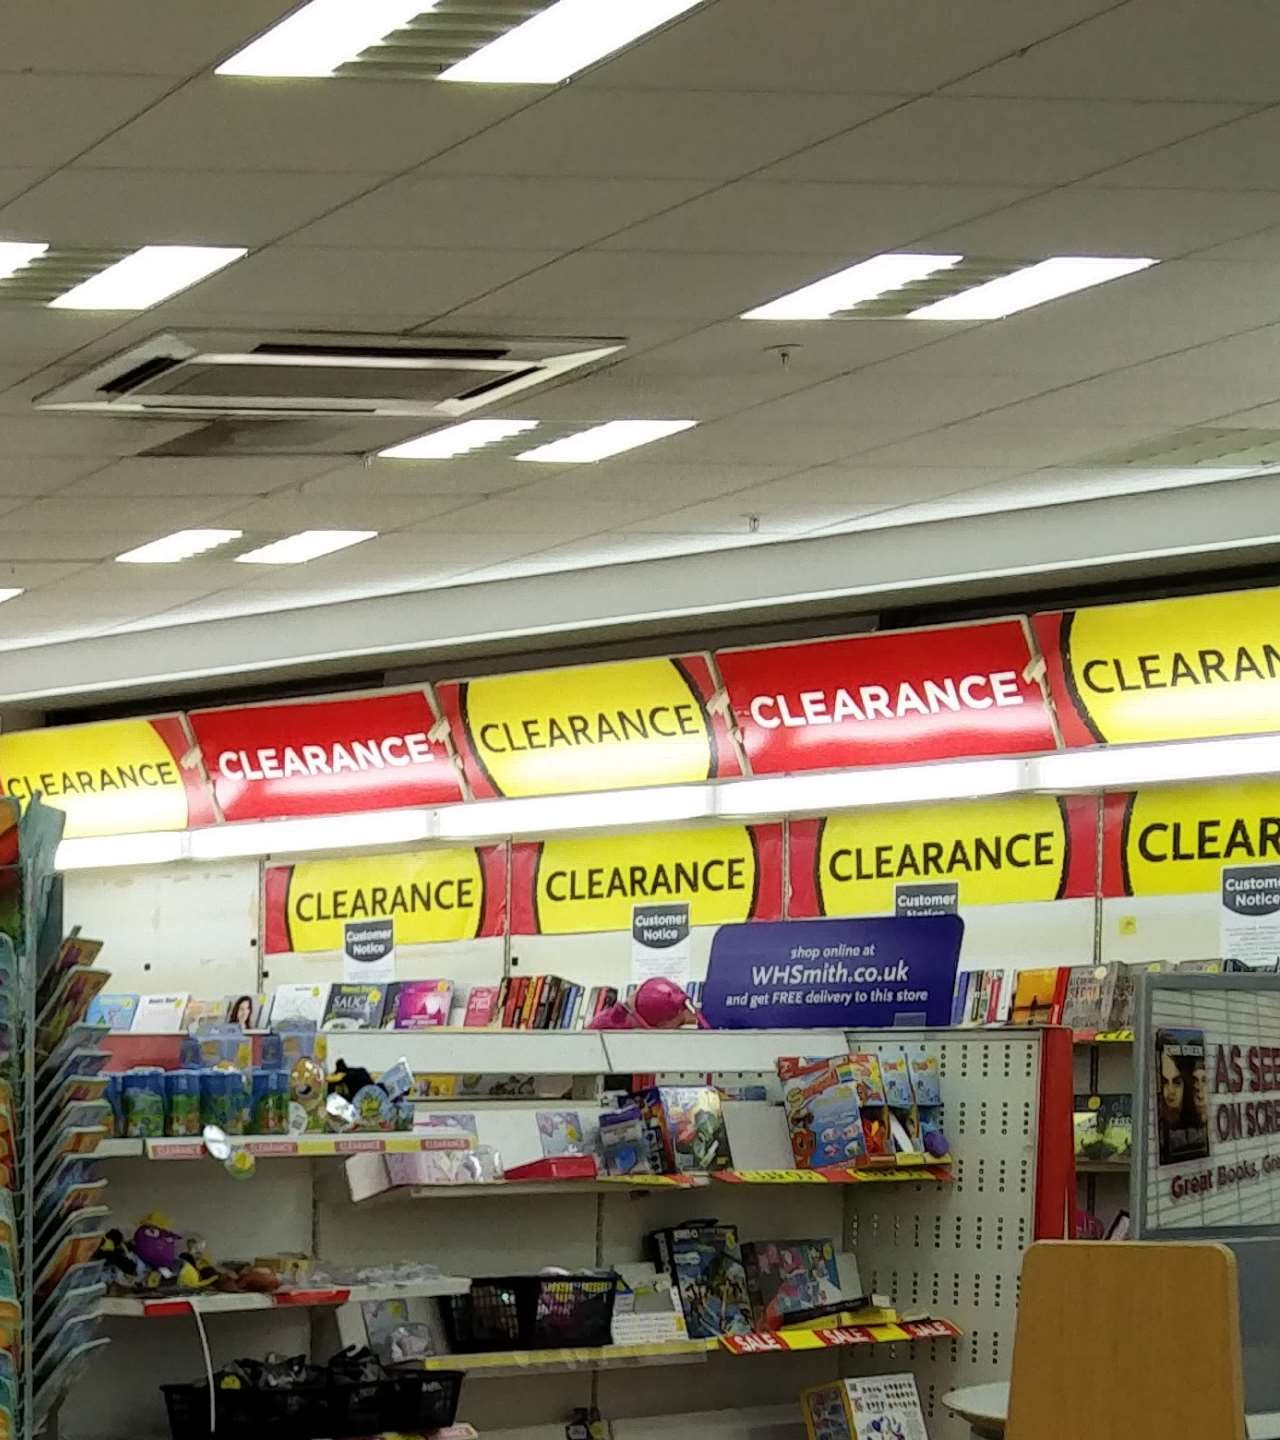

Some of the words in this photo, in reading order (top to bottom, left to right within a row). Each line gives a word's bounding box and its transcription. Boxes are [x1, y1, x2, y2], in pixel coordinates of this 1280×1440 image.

[1082, 640, 1280, 694] CLEARAN
[749, 669, 1024, 730] CLEARANCE
[480, 703, 696, 756] CLEARANCE
[217, 732, 435, 783] CLEARANCE
[7, 760, 178, 803] CLEARANCE
[1138, 816, 1280, 862] CLEAR
[829, 831, 1056, 881] CLEARANCE
[546, 858, 745, 901] CLEARANCE
[1225, 876, 1280, 892] Custom
[296, 878, 474, 923] CLEARANCE
[897, 893, 956, 908] Customer
[346, 926, 393, 944] Customer
[635, 914, 687, 928] Customer
[643, 928, 678, 941] Notice
[352, 942, 385, 956] Notice
[790, 945, 820, 961] shop
[823, 944, 860, 958] online
[863, 943, 875, 957] at
[751, 960, 909, 987] WHSmith.co.uk
[726, 992, 748, 1006] and
[750, 993, 769, 1008] get
[772, 991, 802, 1005] FREE
[805, 990, 852, 1007] delivery
[855, 991, 867, 1003] to
[869, 989, 893, 1002] this
[897, 989, 928, 1002] store
[1215, 1043, 1244, 1094] AS
[1248, 1045, 1280, 1093] SEE
[1216, 1102, 1243, 1143] ON
[1245, 1099, 1280, 1139] SCRE
[1170, 1169, 1214, 1199] Great
[738, 1331, 783, 1351] SALE
[824, 1327, 870, 1344] SALE
[910, 1320, 950, 1336] SALE
